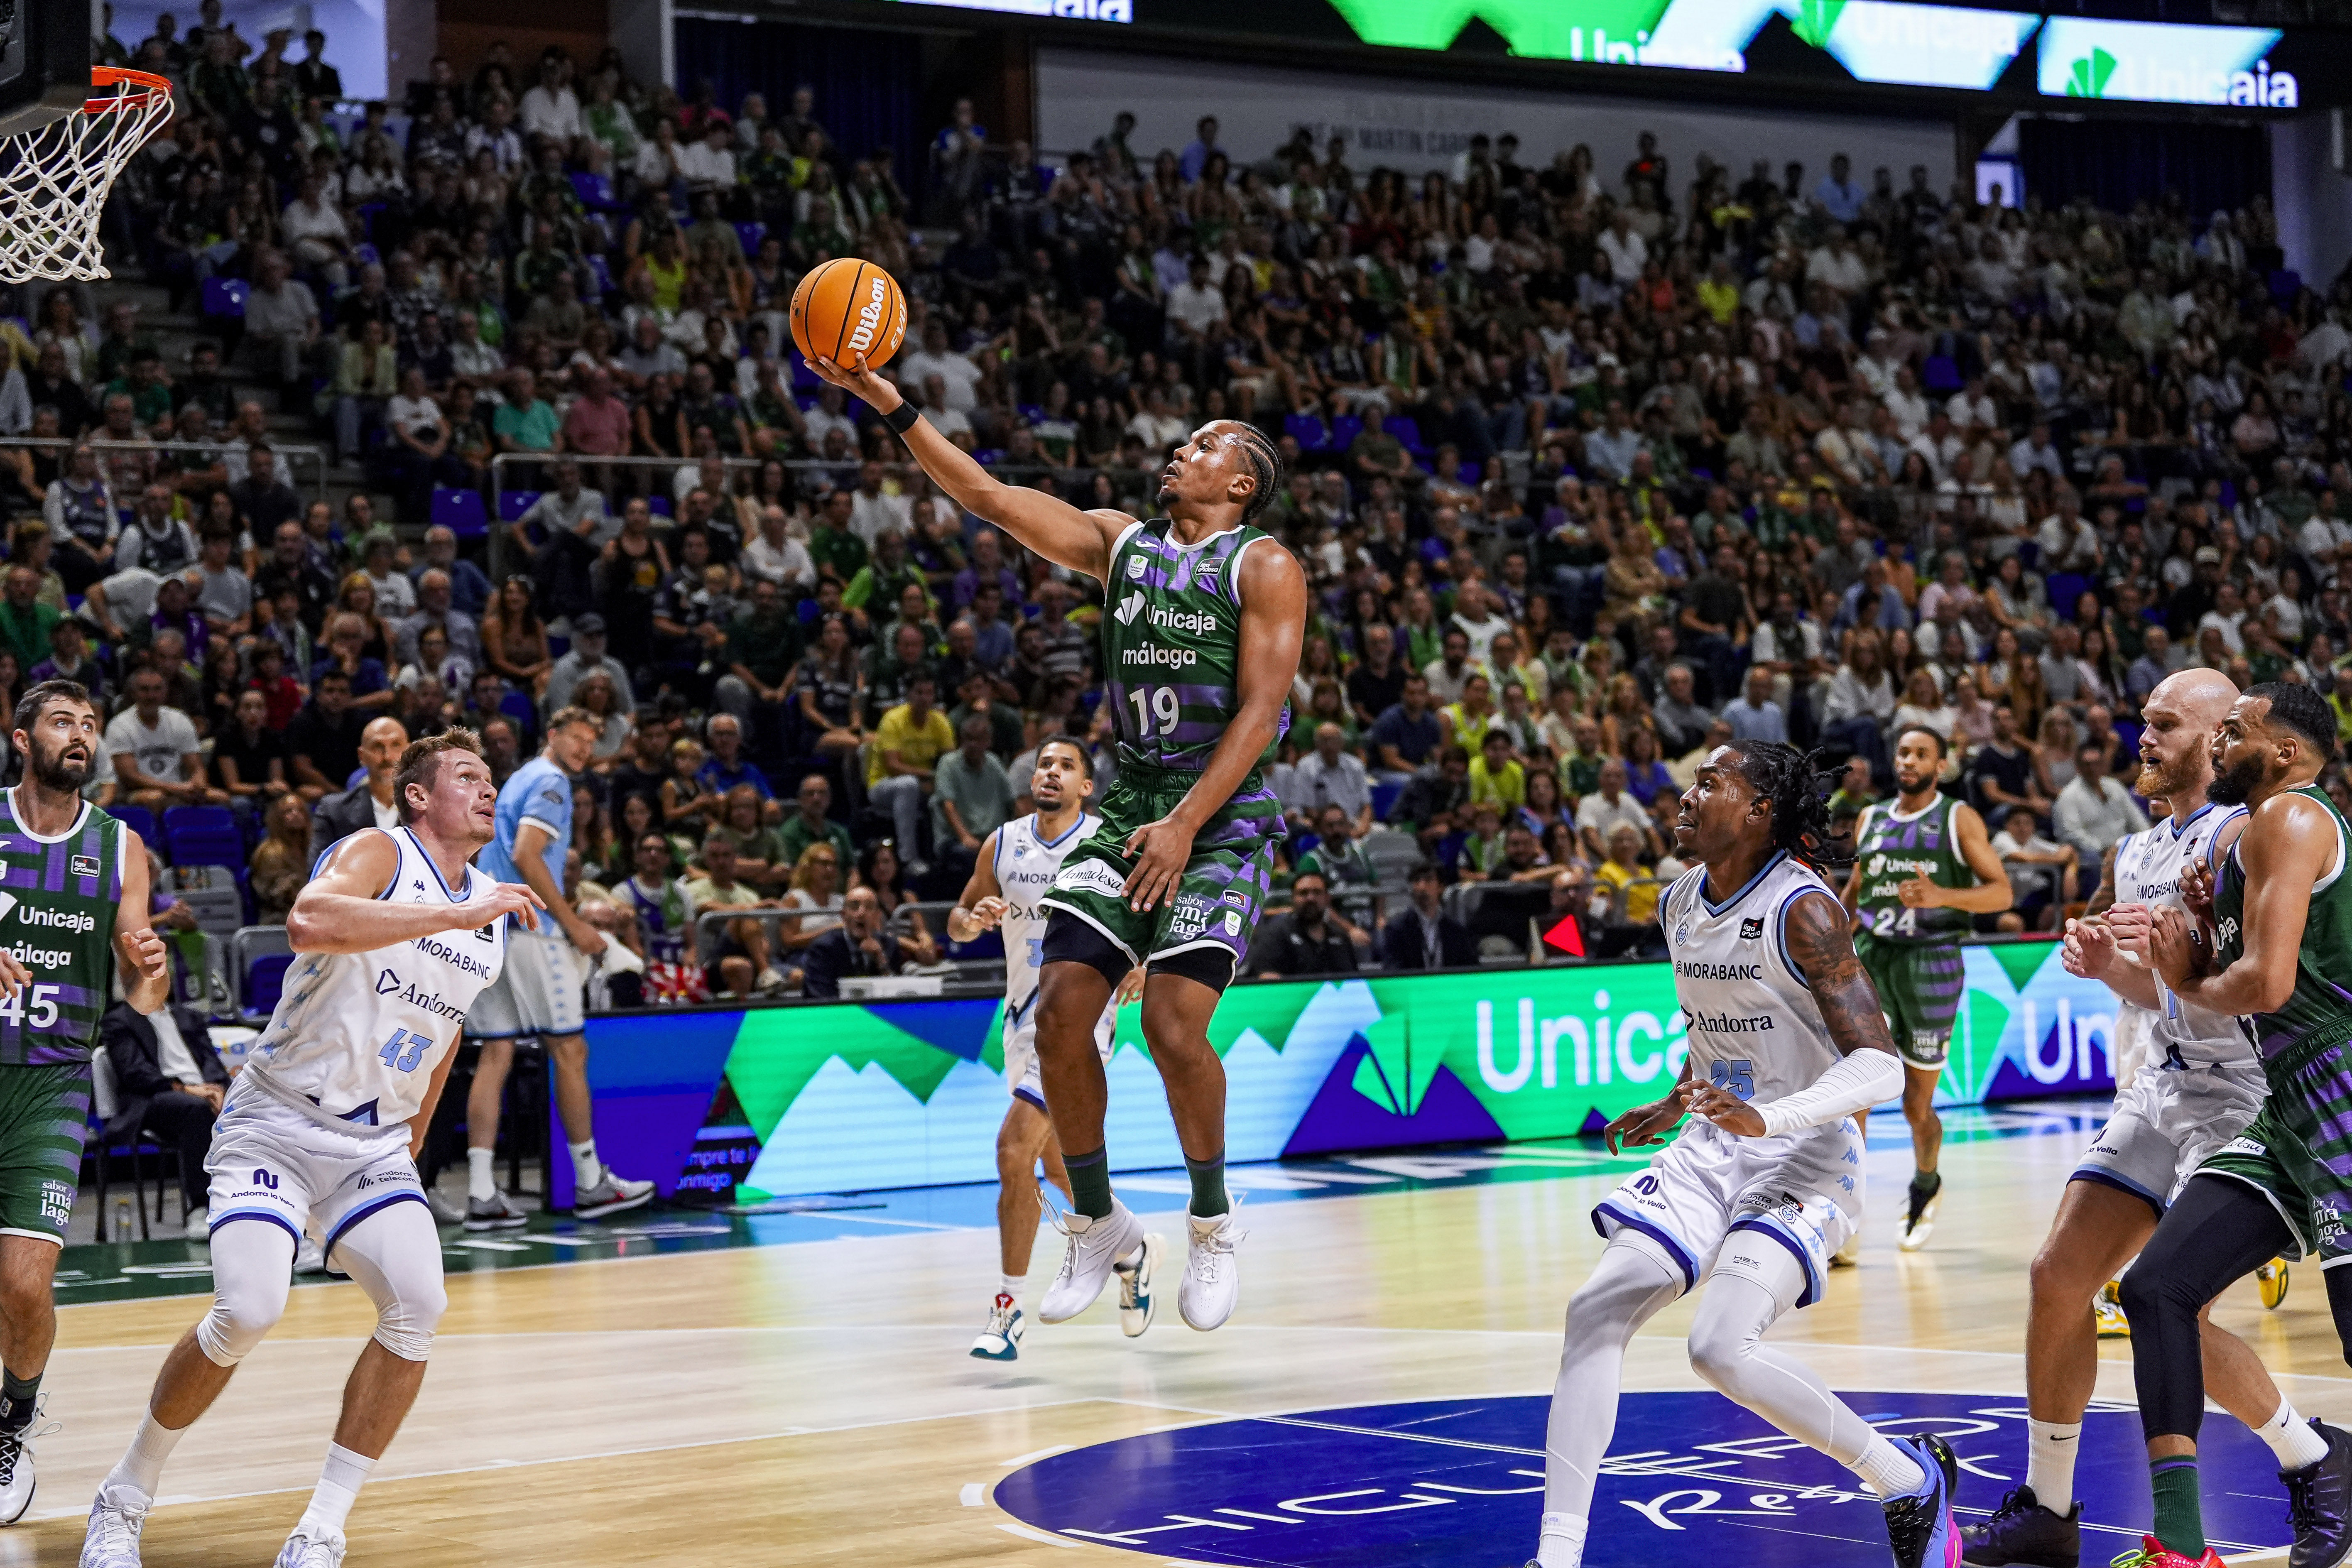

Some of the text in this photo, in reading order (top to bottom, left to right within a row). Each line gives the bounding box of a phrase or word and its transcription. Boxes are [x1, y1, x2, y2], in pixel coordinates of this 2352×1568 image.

[847, 277, 884, 350] Wilson
[1146, 604, 1216, 636] Unicaja
[1122, 641, 1196, 670] málaga
[1129, 686, 1179, 735] 19
[1019, 872, 1056, 884] MORA
[1177, 894, 1205, 907] sabor
[1226, 895, 1242, 904] acb
[18, 906, 95, 934] Unicaja
[1743, 924, 1756, 932] liga
[1873, 907, 1916, 937] 24
[416, 936, 491, 980] MORABANC
[1683, 963, 1762, 980] MORABANC
[0, 983, 60, 1028] 45
[1697, 1010, 1775, 1033] Andorra
[378, 1028, 434, 1073] 43
[1475, 988, 1689, 1094] Unica
[1710, 1059, 1755, 1101] 25
[2097, 1146, 2118, 1156] Vella
[42, 1180, 68, 1193] sabor
[230, 1191, 269, 1199] Andorra
[40, 1199, 70, 1226] laga
[47, 1191, 72, 1211] má
[1647, 1200, 1666, 1210] Vella
[1784, 1197, 1799, 1210] acb
[2317, 1222, 2349, 1246] aga
[1733, 1255, 1761, 1267] HEX
